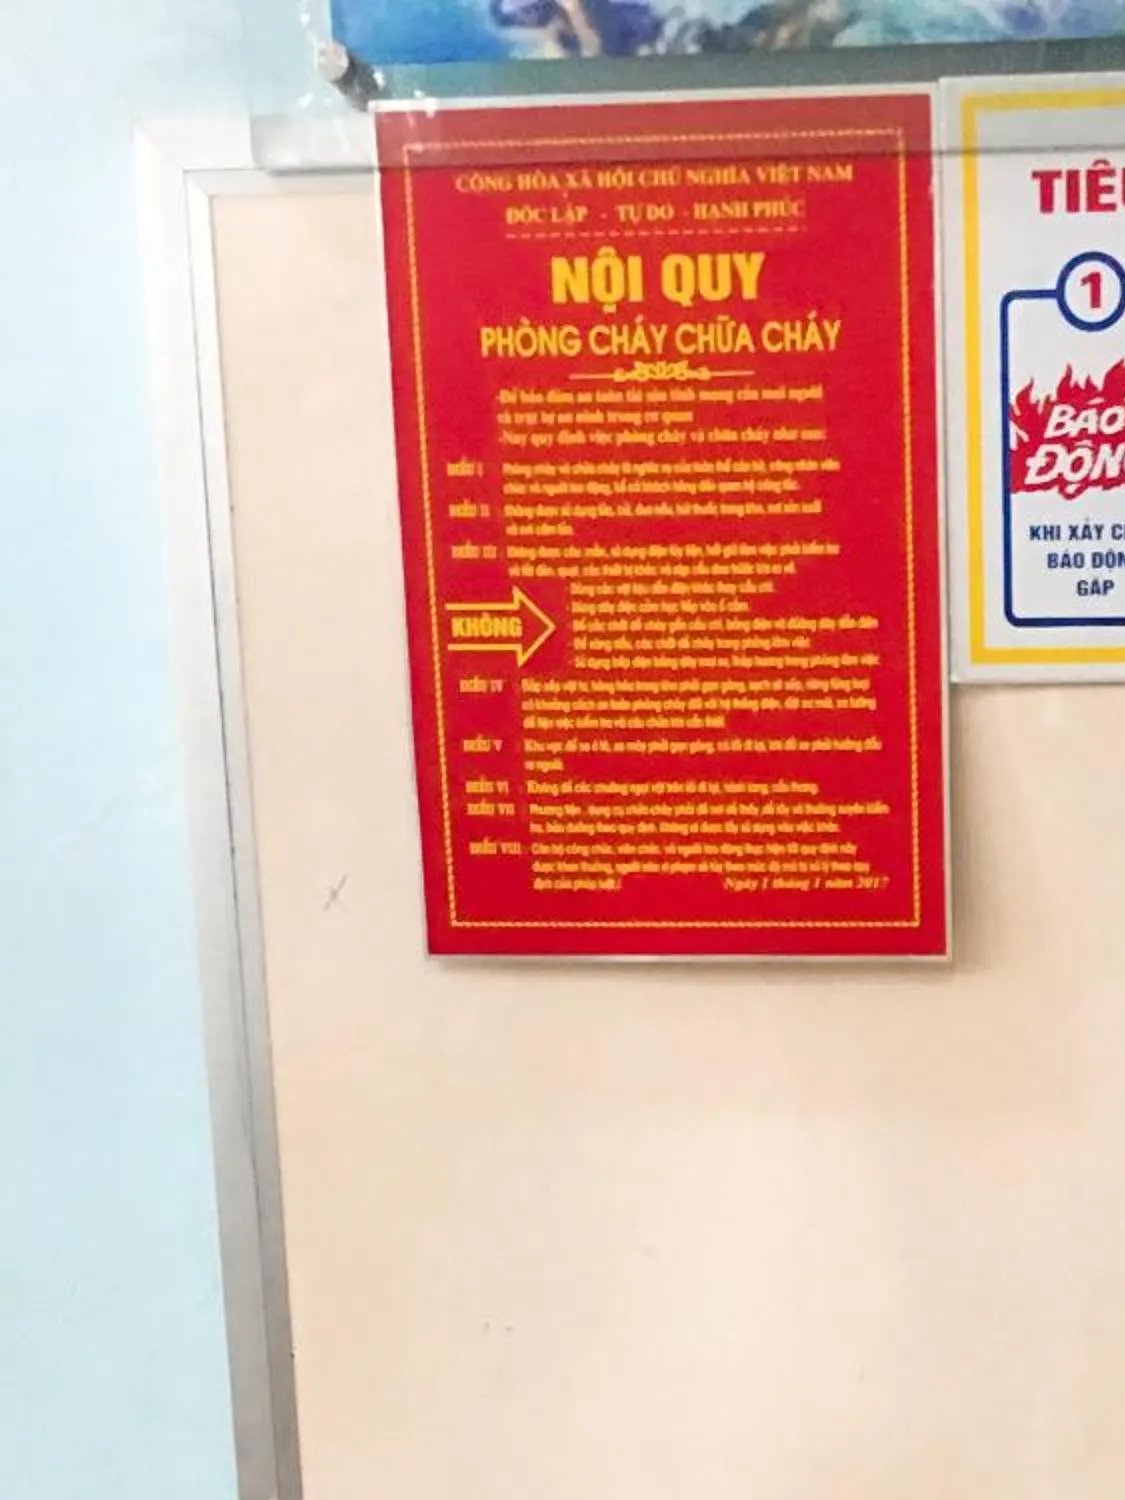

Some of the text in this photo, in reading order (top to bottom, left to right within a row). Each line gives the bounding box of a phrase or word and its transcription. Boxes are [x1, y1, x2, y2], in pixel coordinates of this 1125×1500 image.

[756, 162, 802, 185] VIỆT
[808, 164, 854, 182] NAM
[550, 246, 766, 313] NỘI QUY
[1080, 271, 1102, 309] 1
[480, 310, 842, 358] PHÒNG CHÁY CHỮA CHÁY
[1029, 524, 1061, 541] KHI
[1068, 517, 1104, 540] XẢY
[451, 611, 523, 638] KHÔNG
